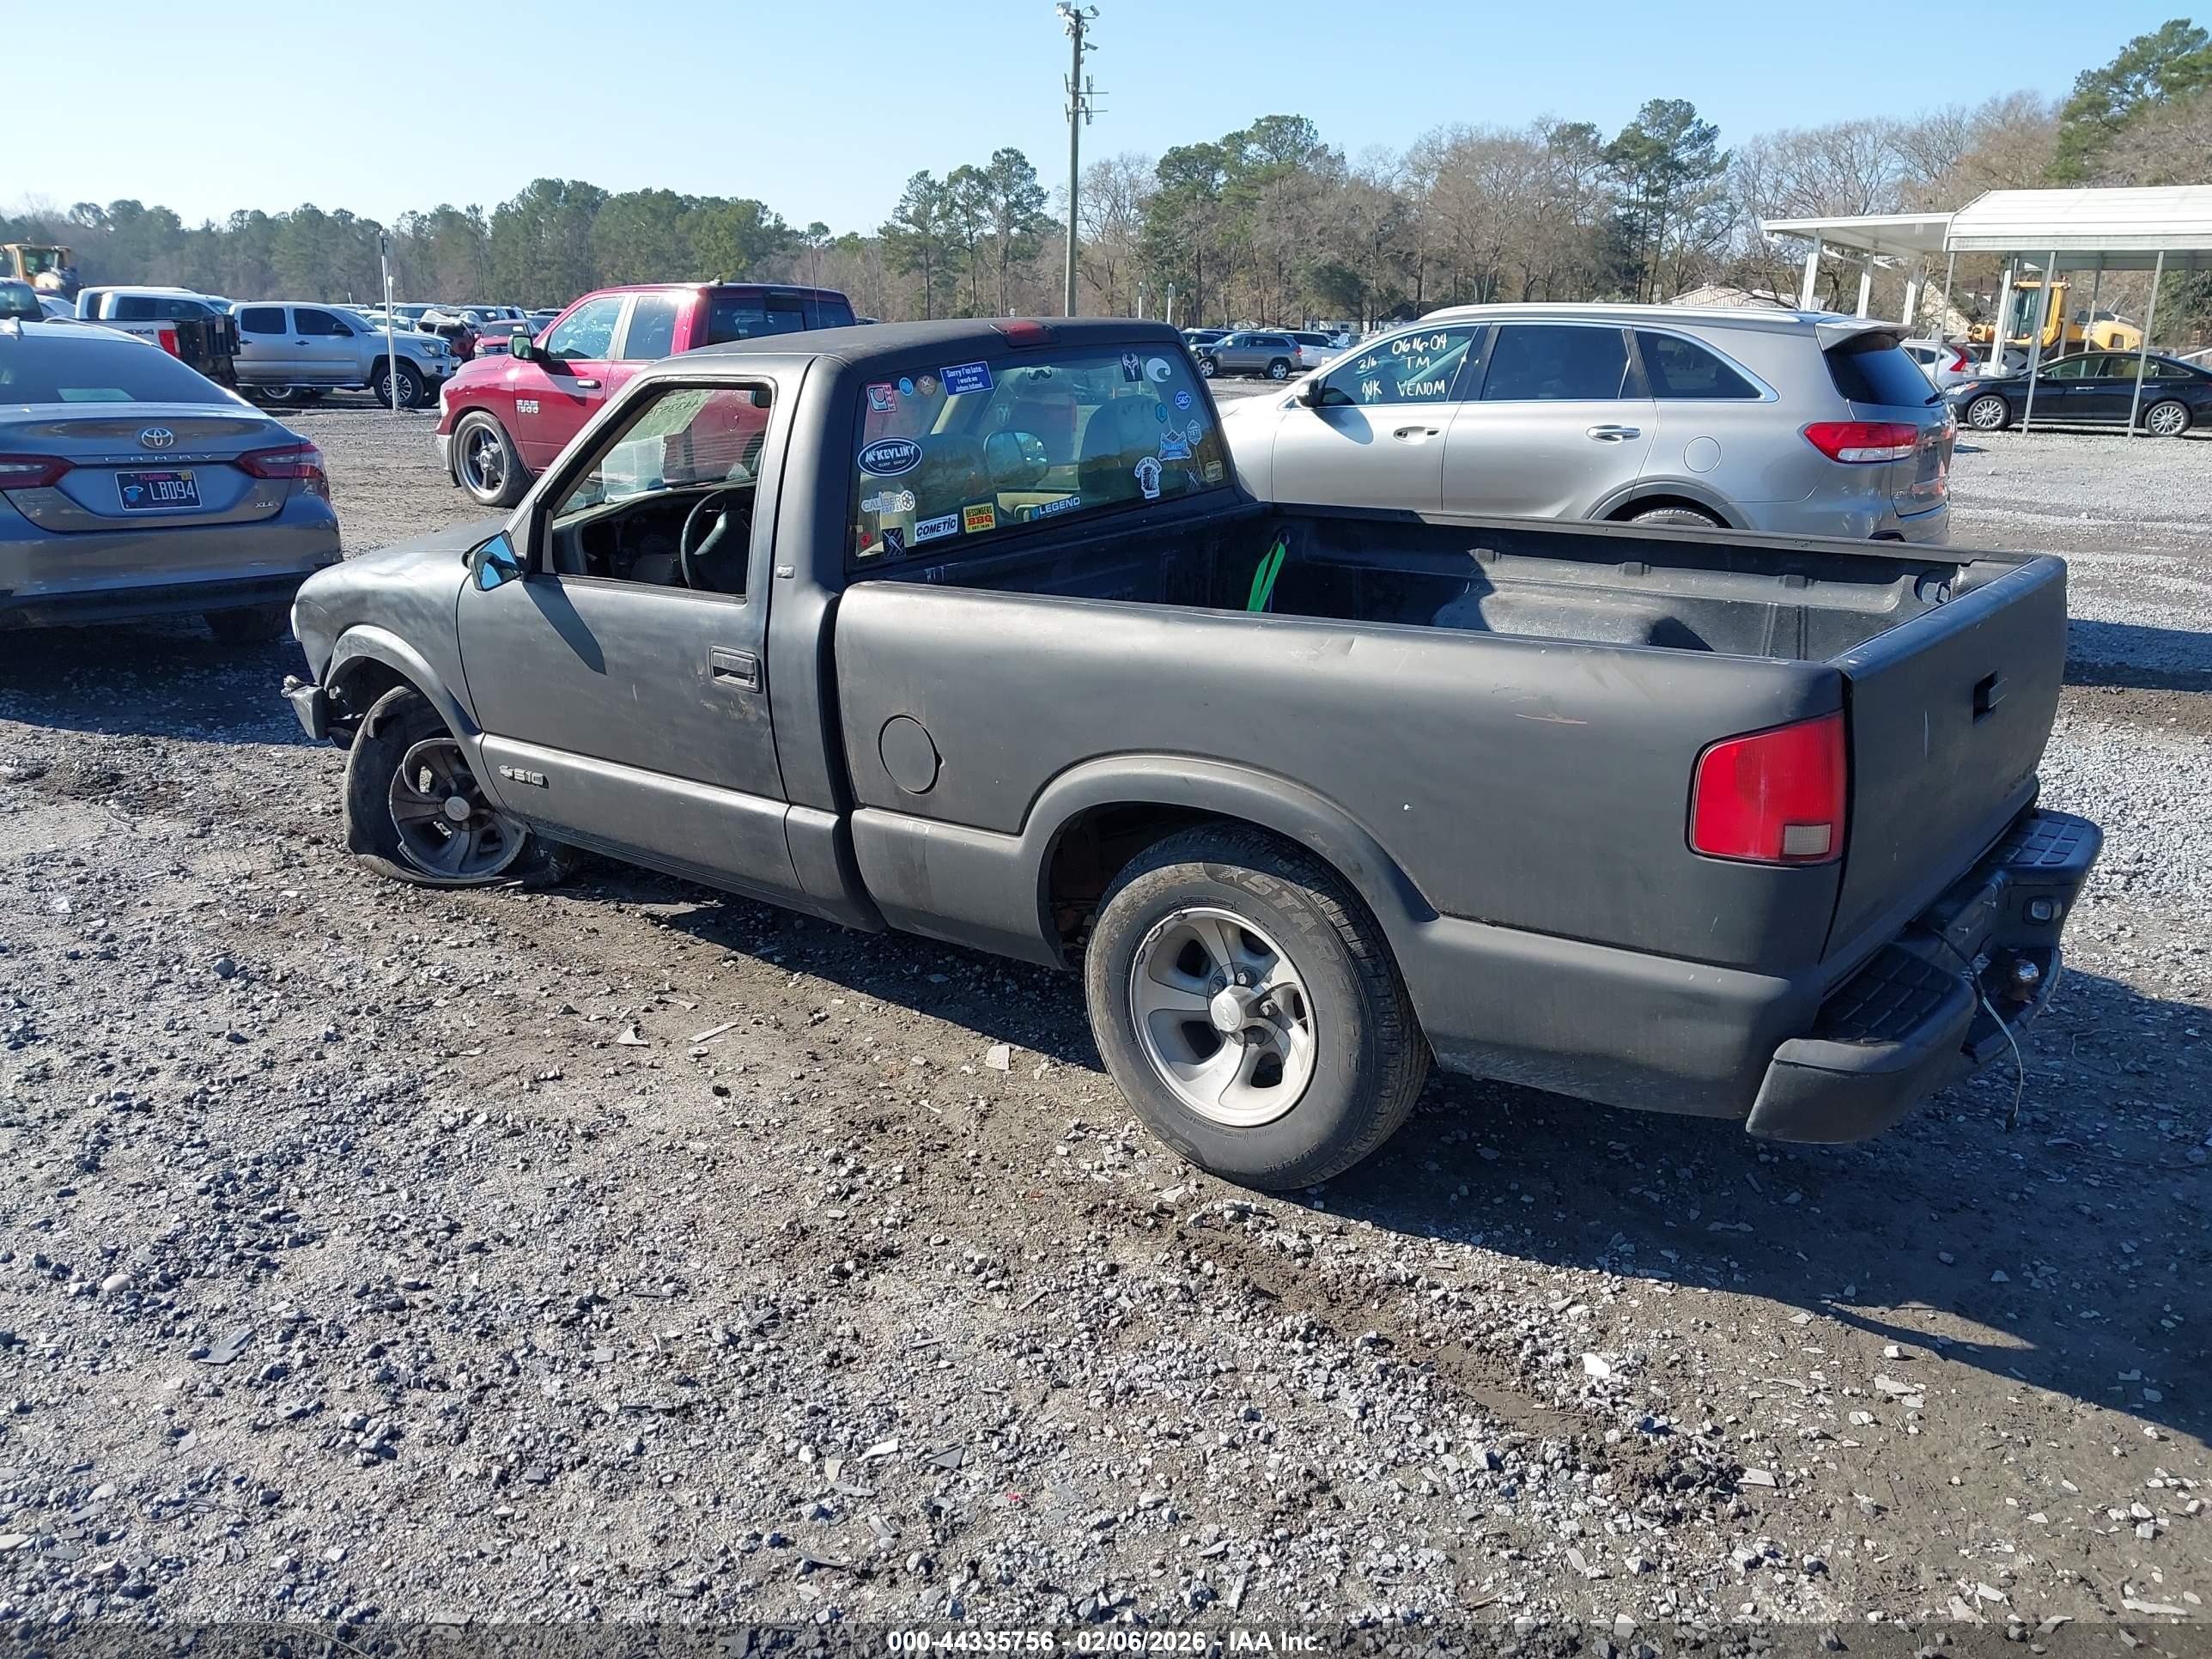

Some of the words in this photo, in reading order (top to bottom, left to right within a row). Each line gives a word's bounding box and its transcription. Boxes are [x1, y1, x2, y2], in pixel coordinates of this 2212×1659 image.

[1402, 356, 1430, 370] TM
[1362, 380, 1382, 397] NK
[1396, 380, 1446, 397] VENOM
[516, 405, 539, 414] 1500
[149, 481, 196, 501] LBD94
[1039, 497, 1081, 515] LEGEND
[967, 514, 994, 526] BBQ
